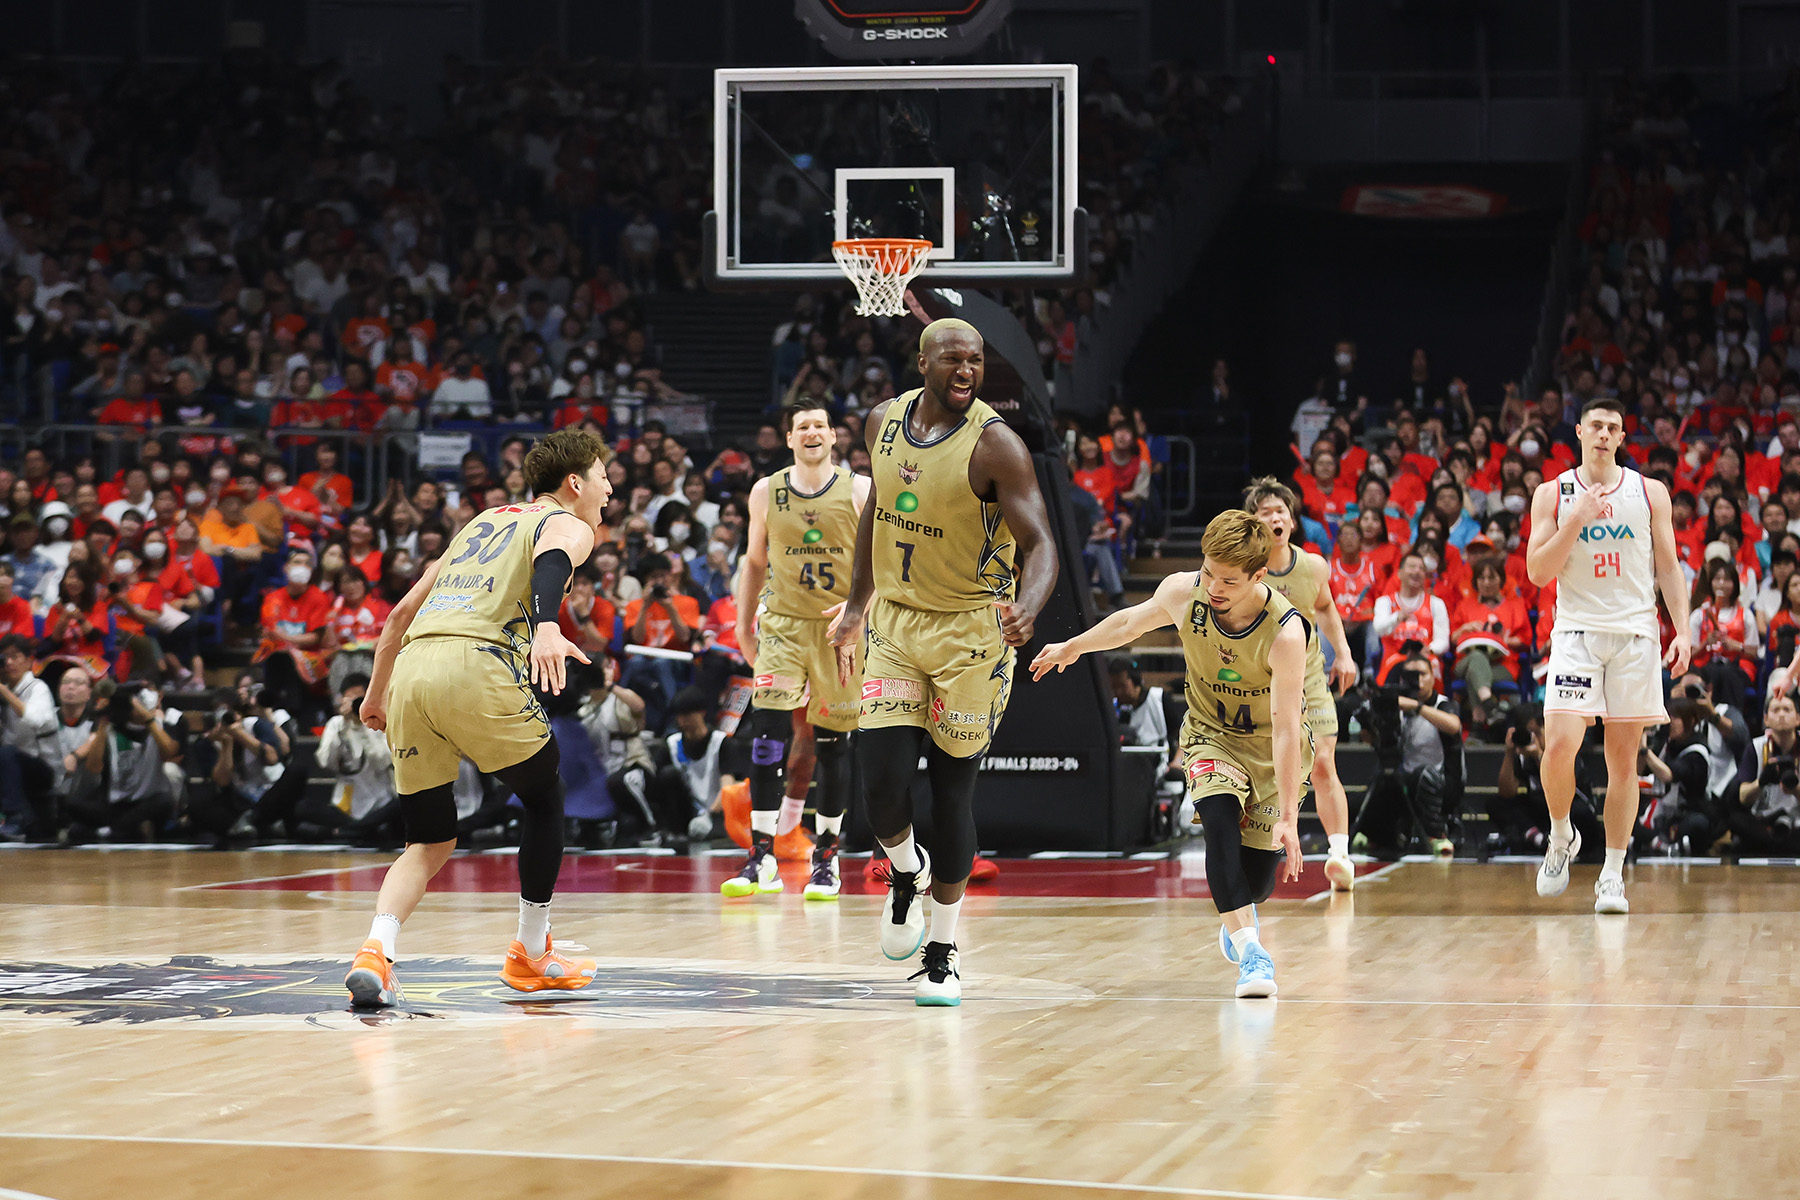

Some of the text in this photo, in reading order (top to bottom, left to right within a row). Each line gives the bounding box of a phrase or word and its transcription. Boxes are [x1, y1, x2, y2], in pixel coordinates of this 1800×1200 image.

[863, 27, 948, 41] G-SHOCK
[989, 399, 1020, 410] noh
[876, 507, 944, 538] Zenhoren
[1577, 525, 1635, 543] NOVA
[450, 521, 518, 566] 30
[785, 545, 844, 555] Zenhoren
[896, 541, 915, 582] 7
[1594, 552, 1621, 577] 24
[799, 563, 835, 591] 45
[948, 710, 988, 725] 球銀行
[1216, 699, 1257, 734] 14
[938, 722, 985, 741] RYUSEKI
[988, 757, 1028, 770] FINALS
[1029, 757, 1079, 771] 2023-24
[1248, 821, 1271, 832] RYU
